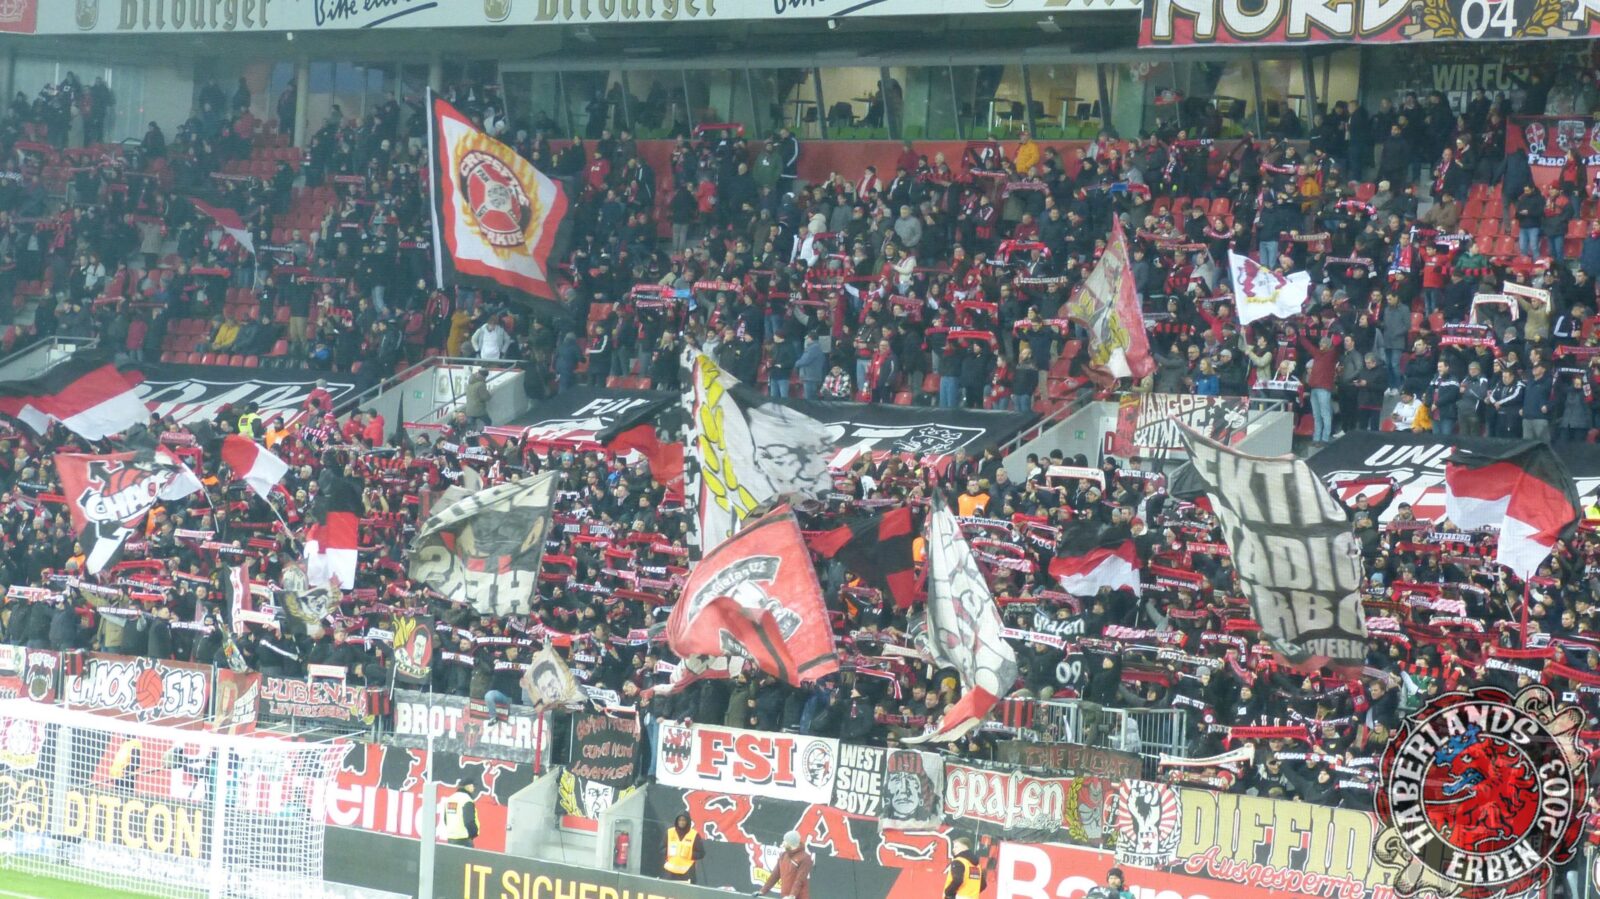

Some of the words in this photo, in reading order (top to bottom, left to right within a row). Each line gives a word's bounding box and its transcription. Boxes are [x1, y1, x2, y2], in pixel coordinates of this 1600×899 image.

[1055, 660, 1082, 684] 09
[164, 671, 206, 717] 513
[695, 729, 798, 788] FSI
[840, 744, 883, 771] WEST
[836, 768, 882, 796] SIDE
[836, 794, 881, 817] BOYZ
[65, 790, 203, 858] DITCON
